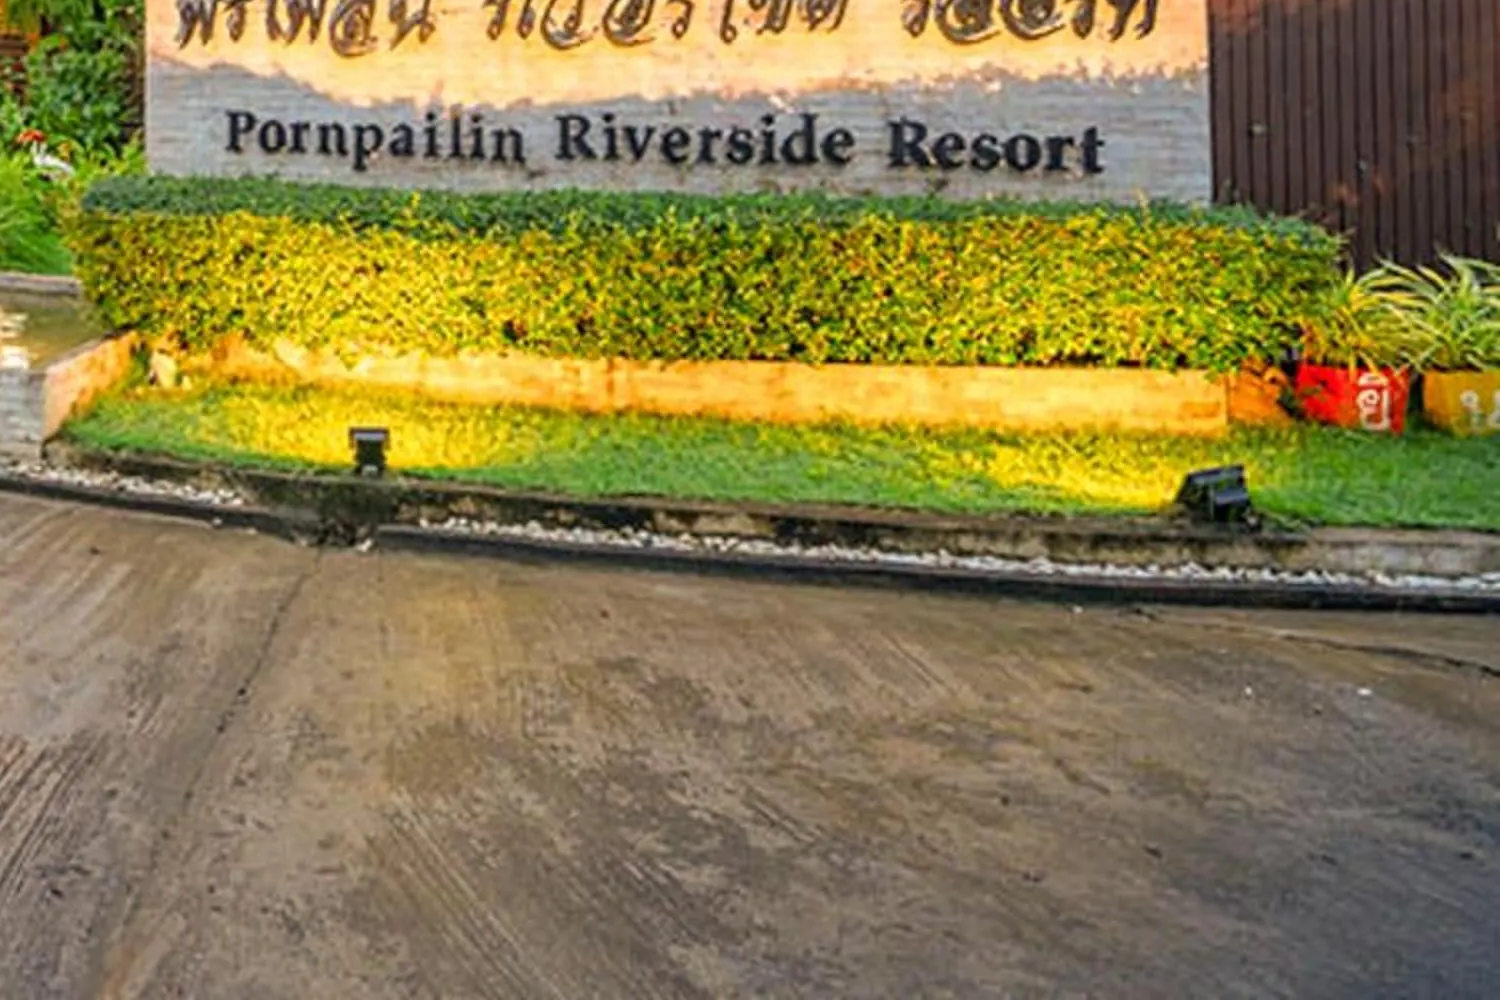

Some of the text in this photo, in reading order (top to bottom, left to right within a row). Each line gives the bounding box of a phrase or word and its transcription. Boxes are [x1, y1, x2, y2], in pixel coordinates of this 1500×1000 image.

[225, 110, 1106, 174] Pornpailin Riverside Resort
